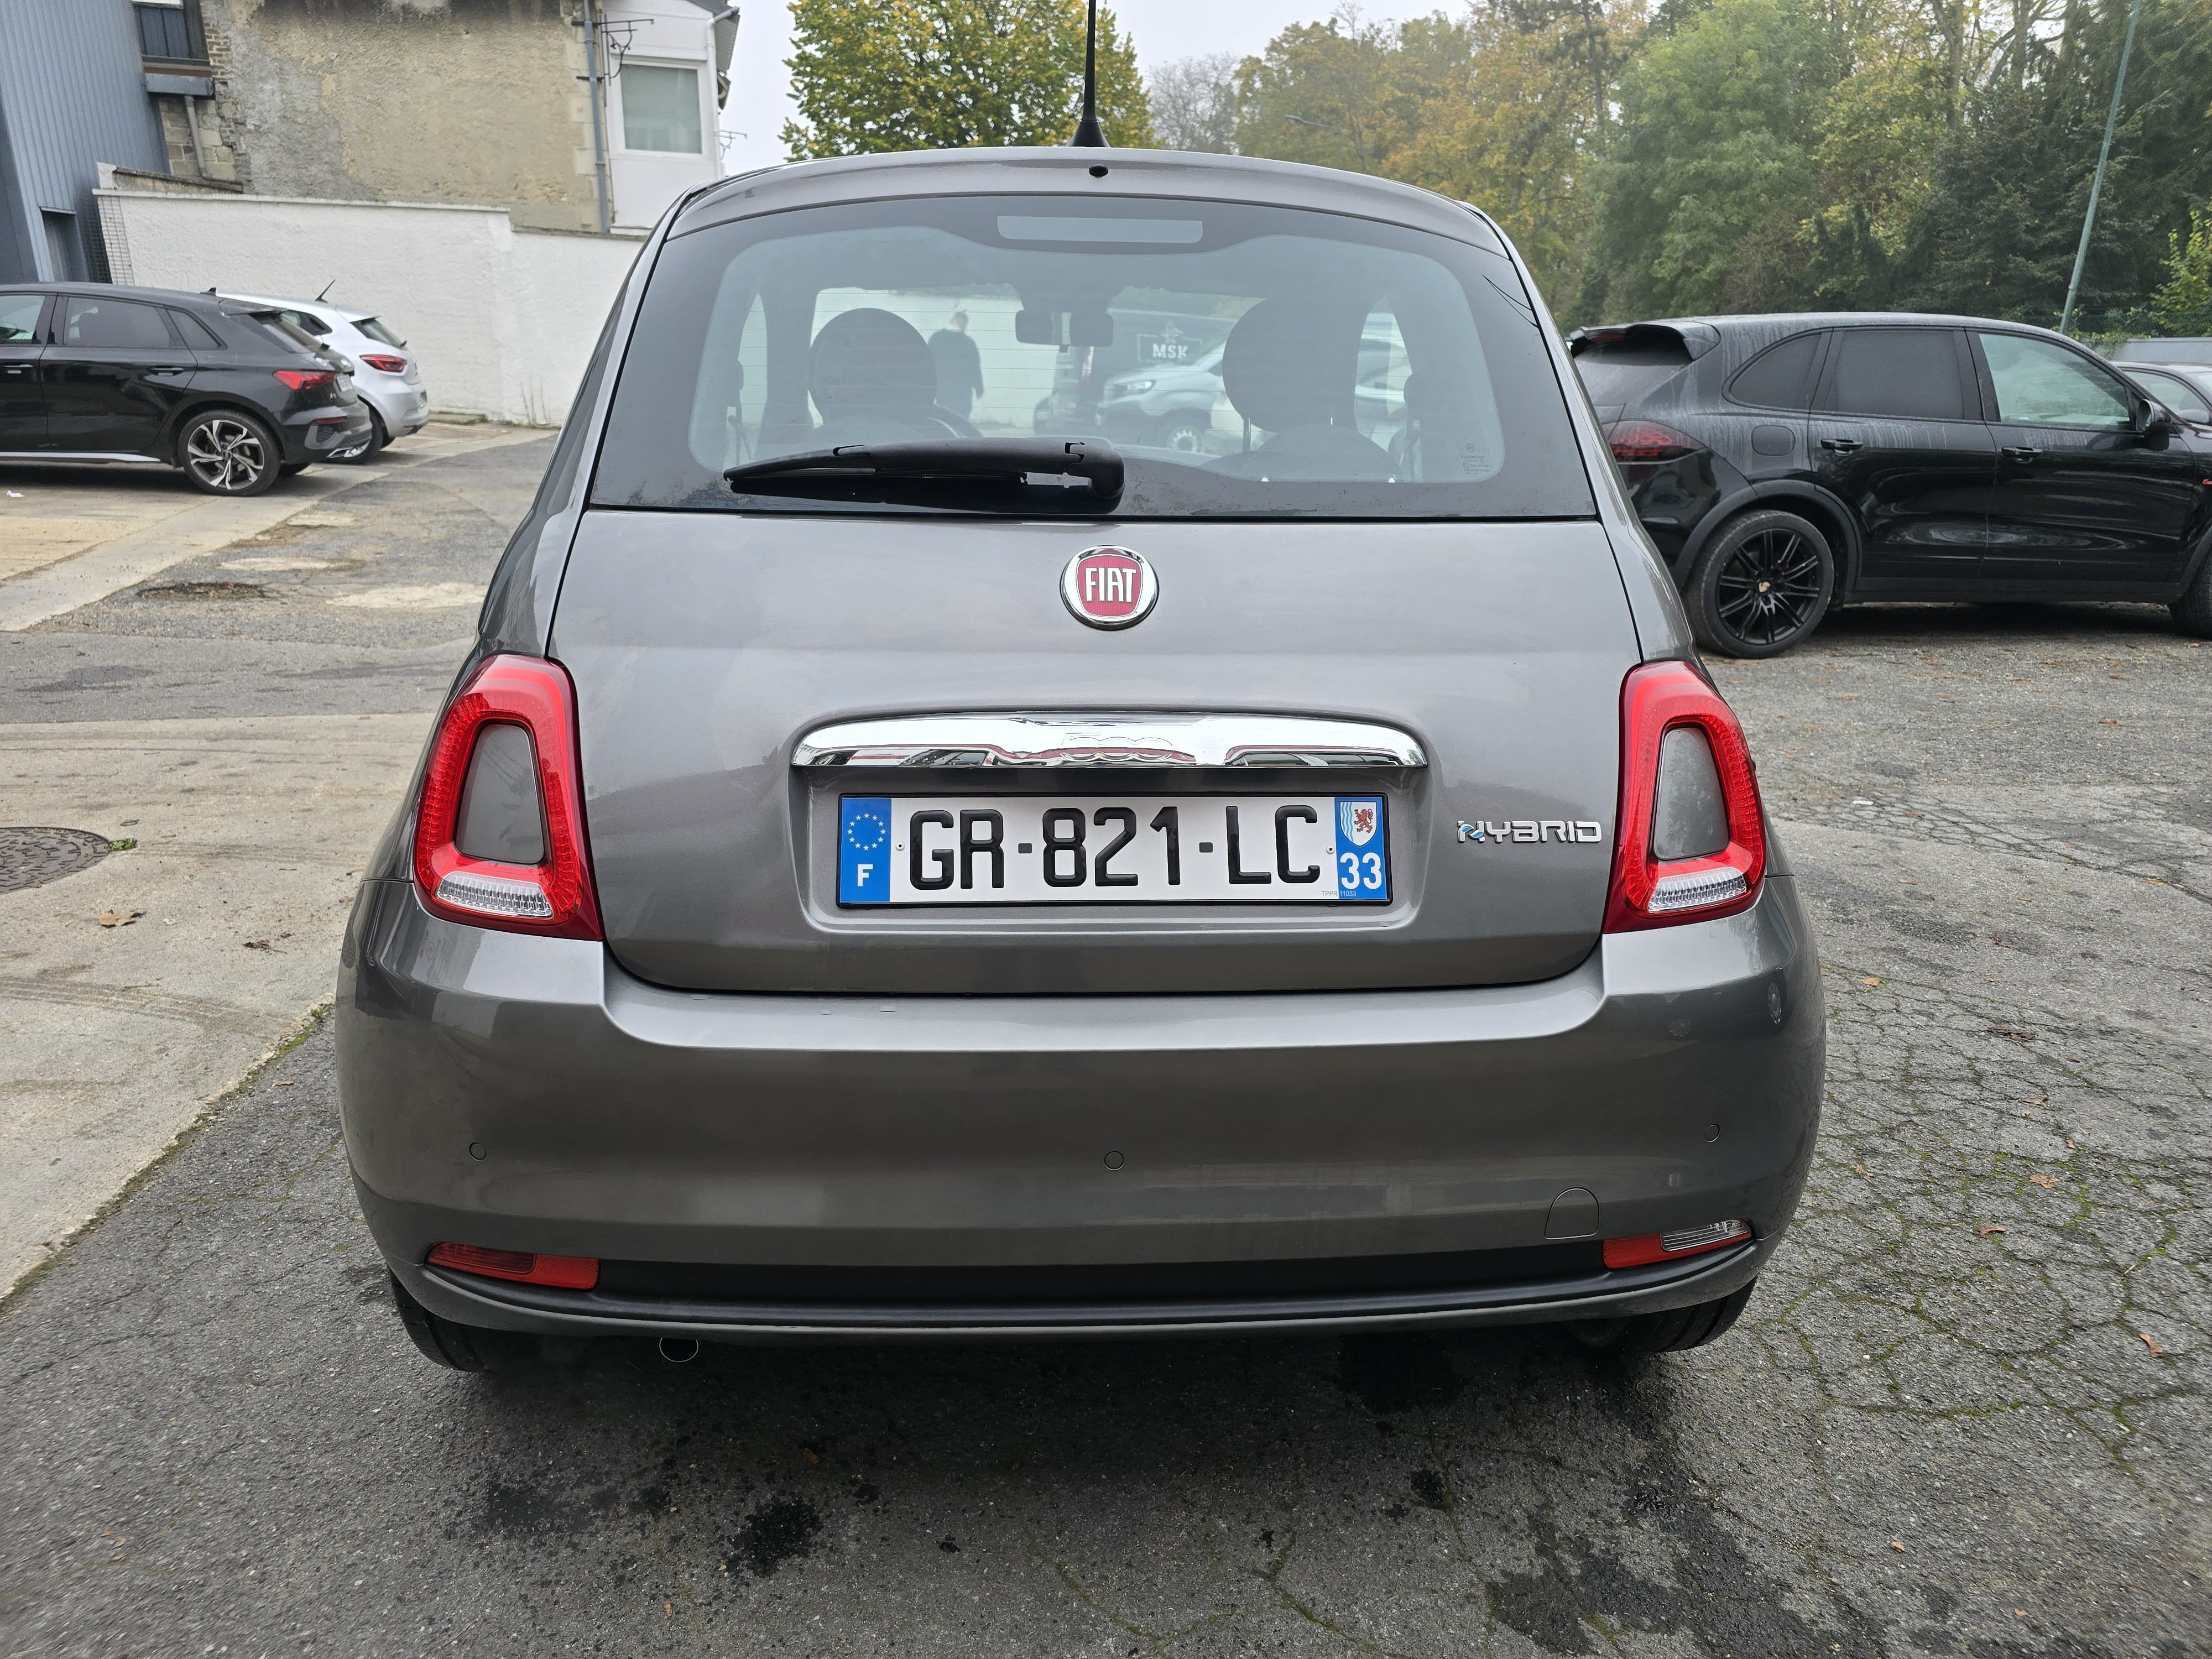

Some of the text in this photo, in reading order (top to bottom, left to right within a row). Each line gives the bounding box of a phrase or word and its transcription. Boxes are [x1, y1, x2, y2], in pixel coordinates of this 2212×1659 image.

[1152, 343, 1188, 359] MSK
[1085, 567, 1136, 603] FIAT
[1457, 820, 1602, 843] HYBRID
[909, 805, 1321, 890] GR-821-LC
[858, 864, 873, 886] F
[1340, 852, 1382, 890] 33
